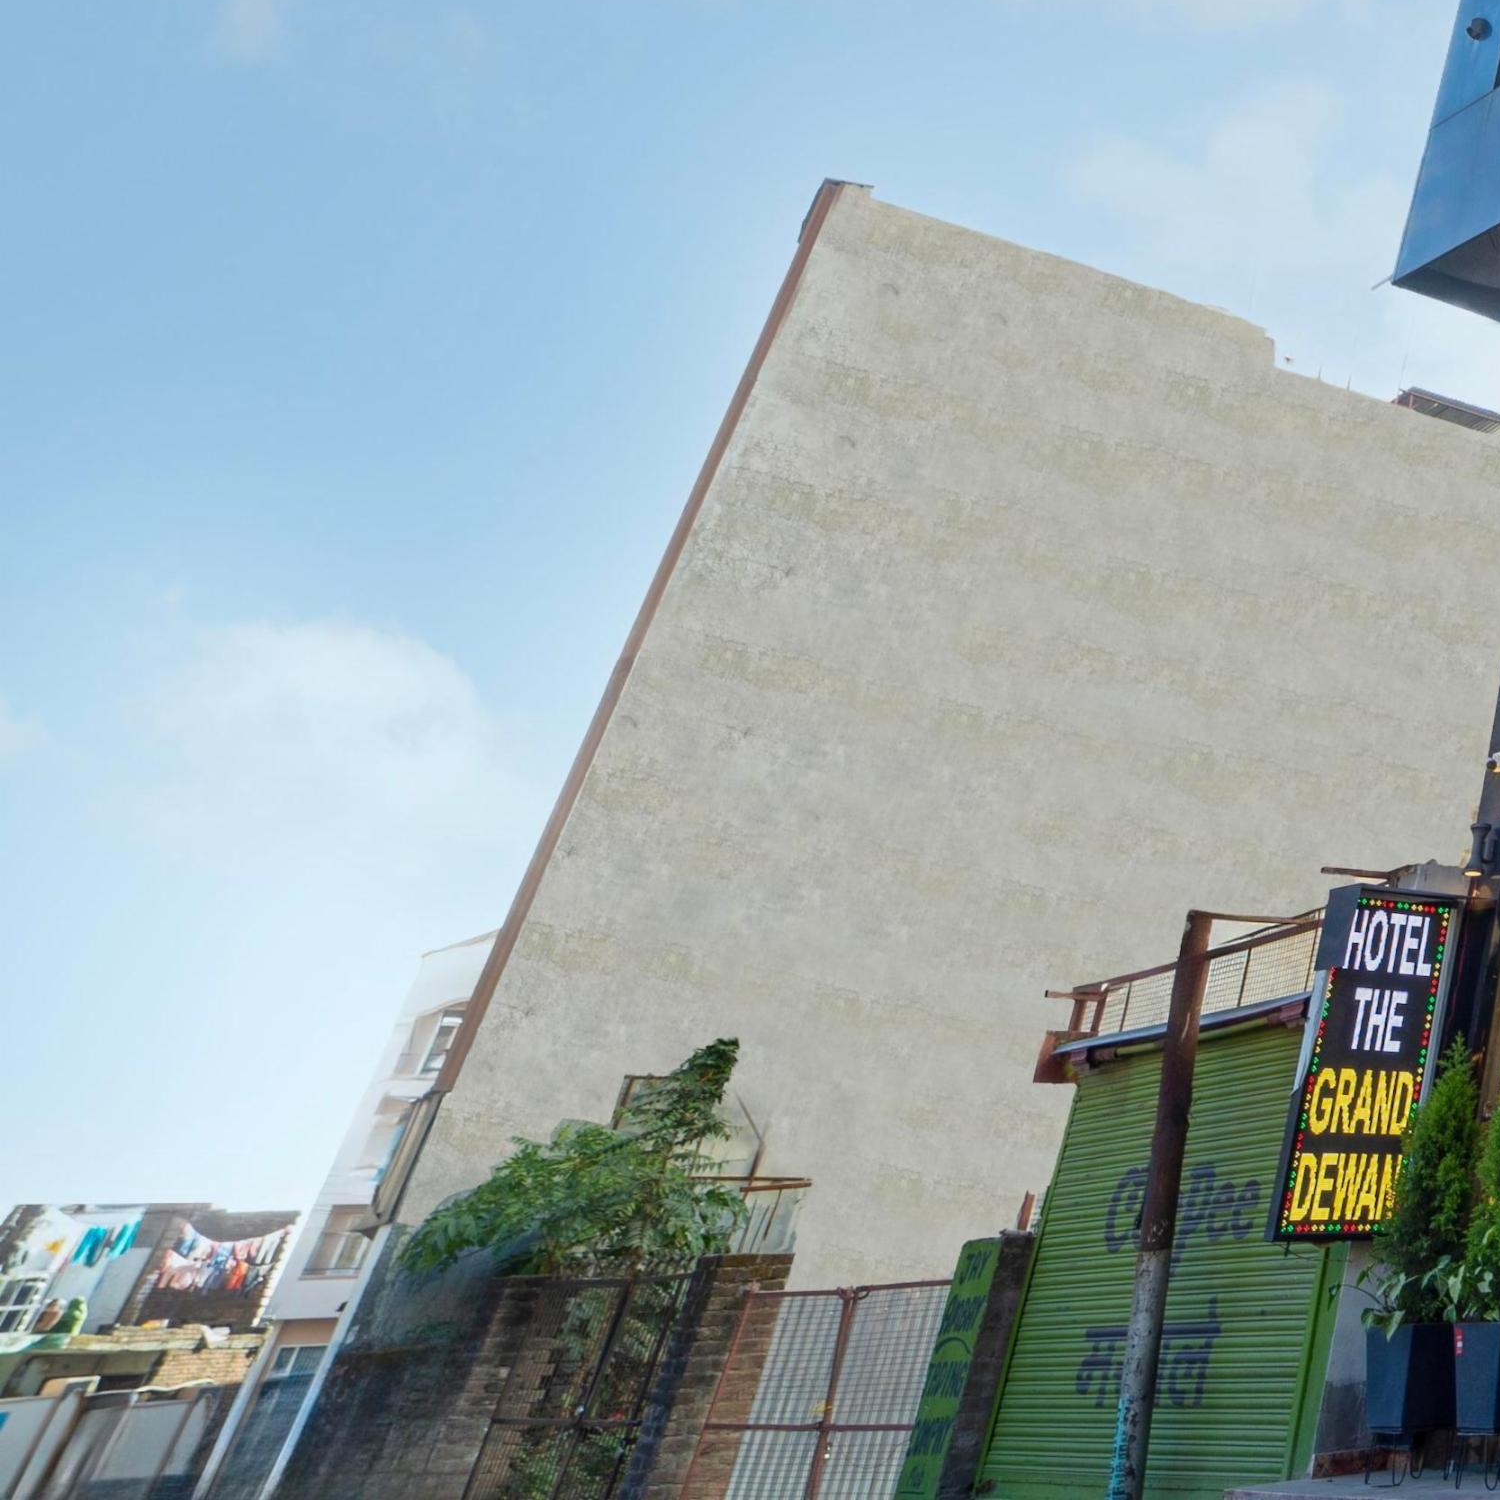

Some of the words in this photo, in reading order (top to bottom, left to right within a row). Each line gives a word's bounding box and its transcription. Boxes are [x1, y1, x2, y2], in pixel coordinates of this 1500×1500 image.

[1342, 908, 1433, 977] HOTEL
[1351, 987, 1409, 1052] THE
[1308, 1067, 1415, 1136] GRAND
